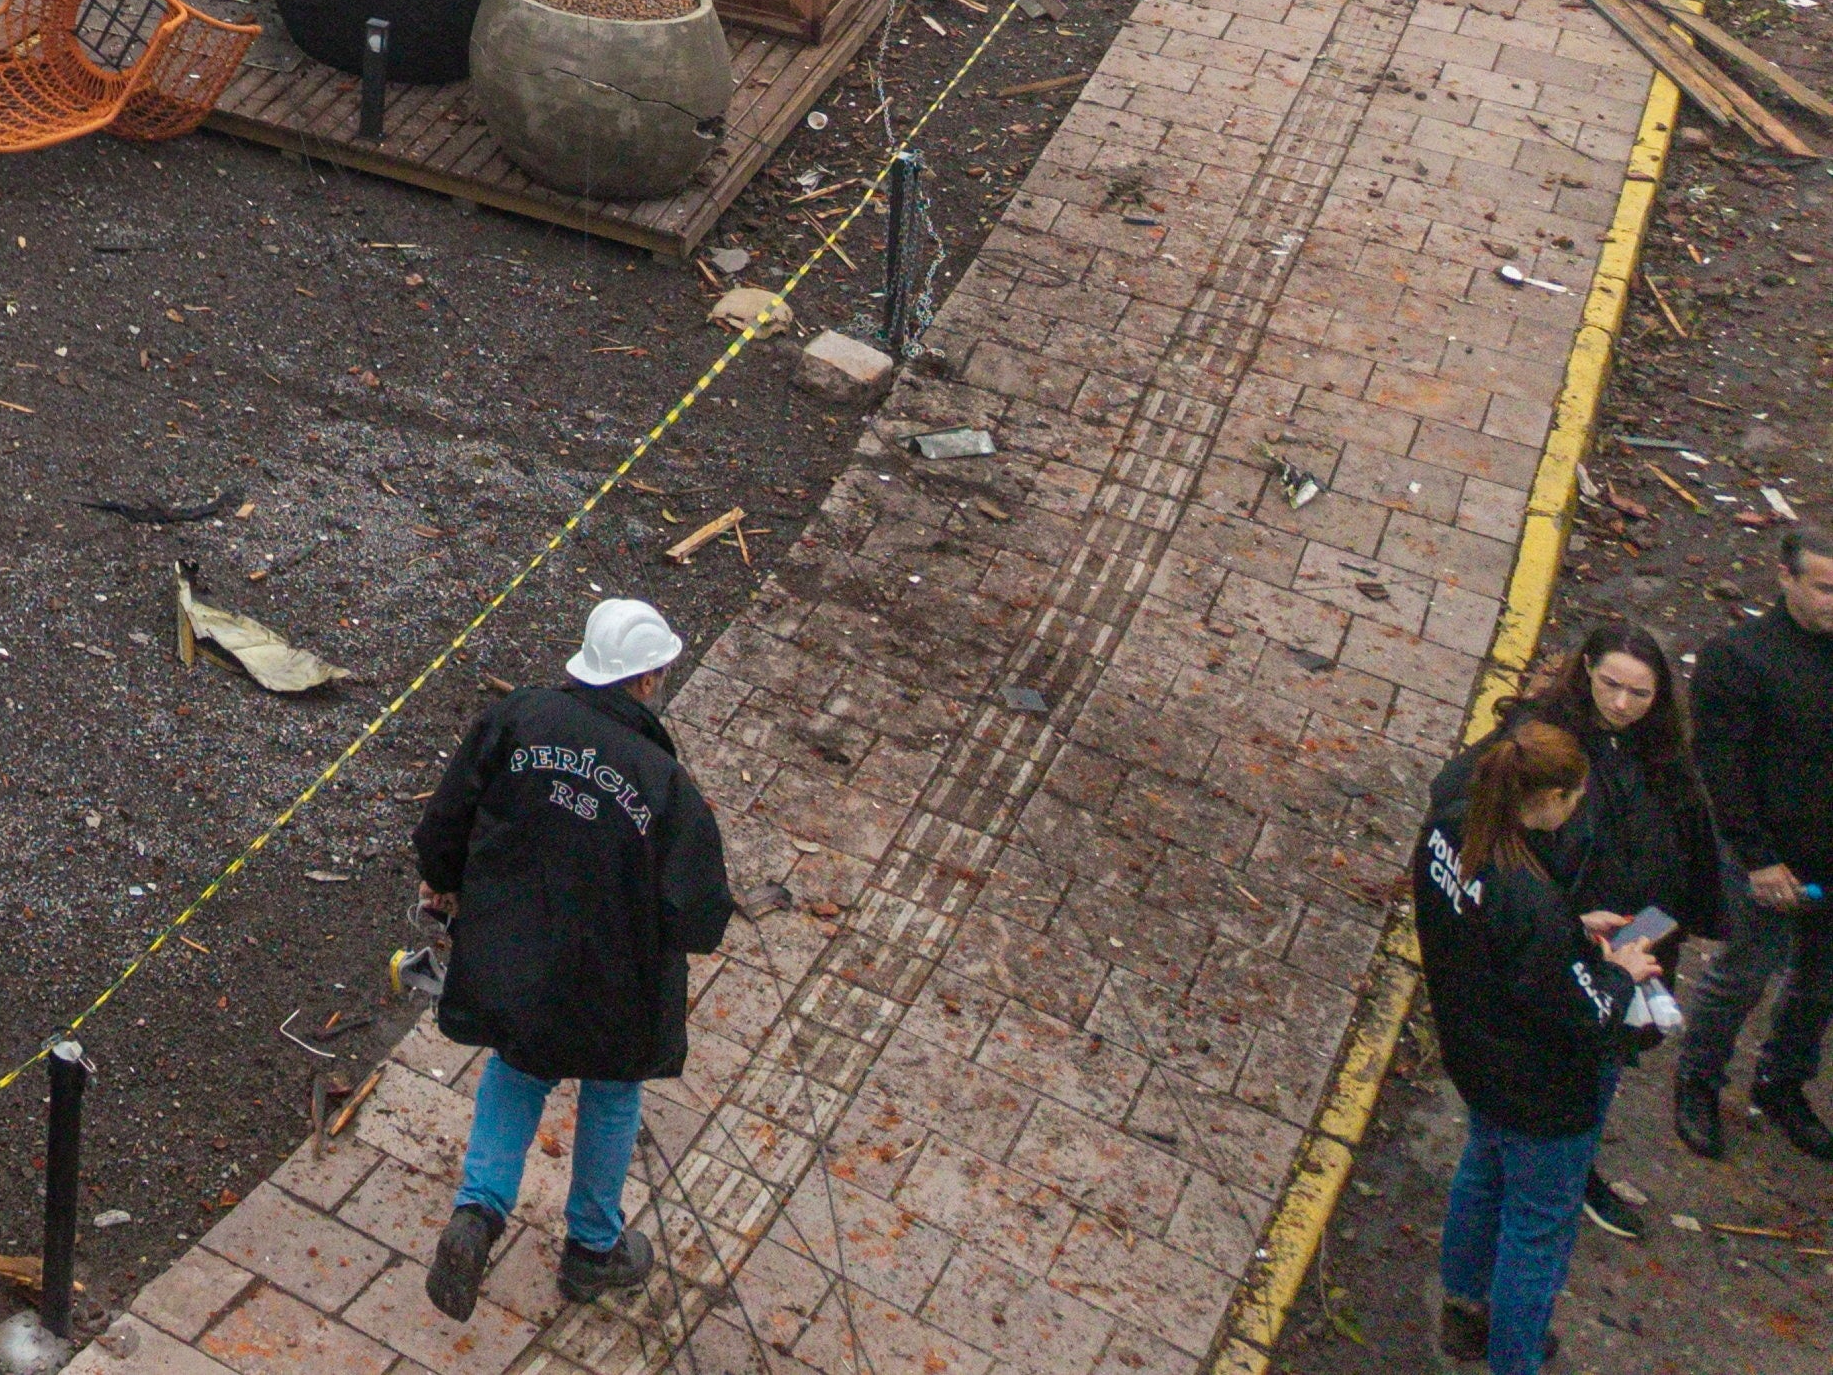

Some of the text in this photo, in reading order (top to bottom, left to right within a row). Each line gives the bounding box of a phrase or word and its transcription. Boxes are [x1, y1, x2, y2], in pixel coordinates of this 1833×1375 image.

[510, 744, 652, 836] PERÍCIA
[549, 779, 599, 821] RS
[1429, 859, 1463, 916] CIVL
